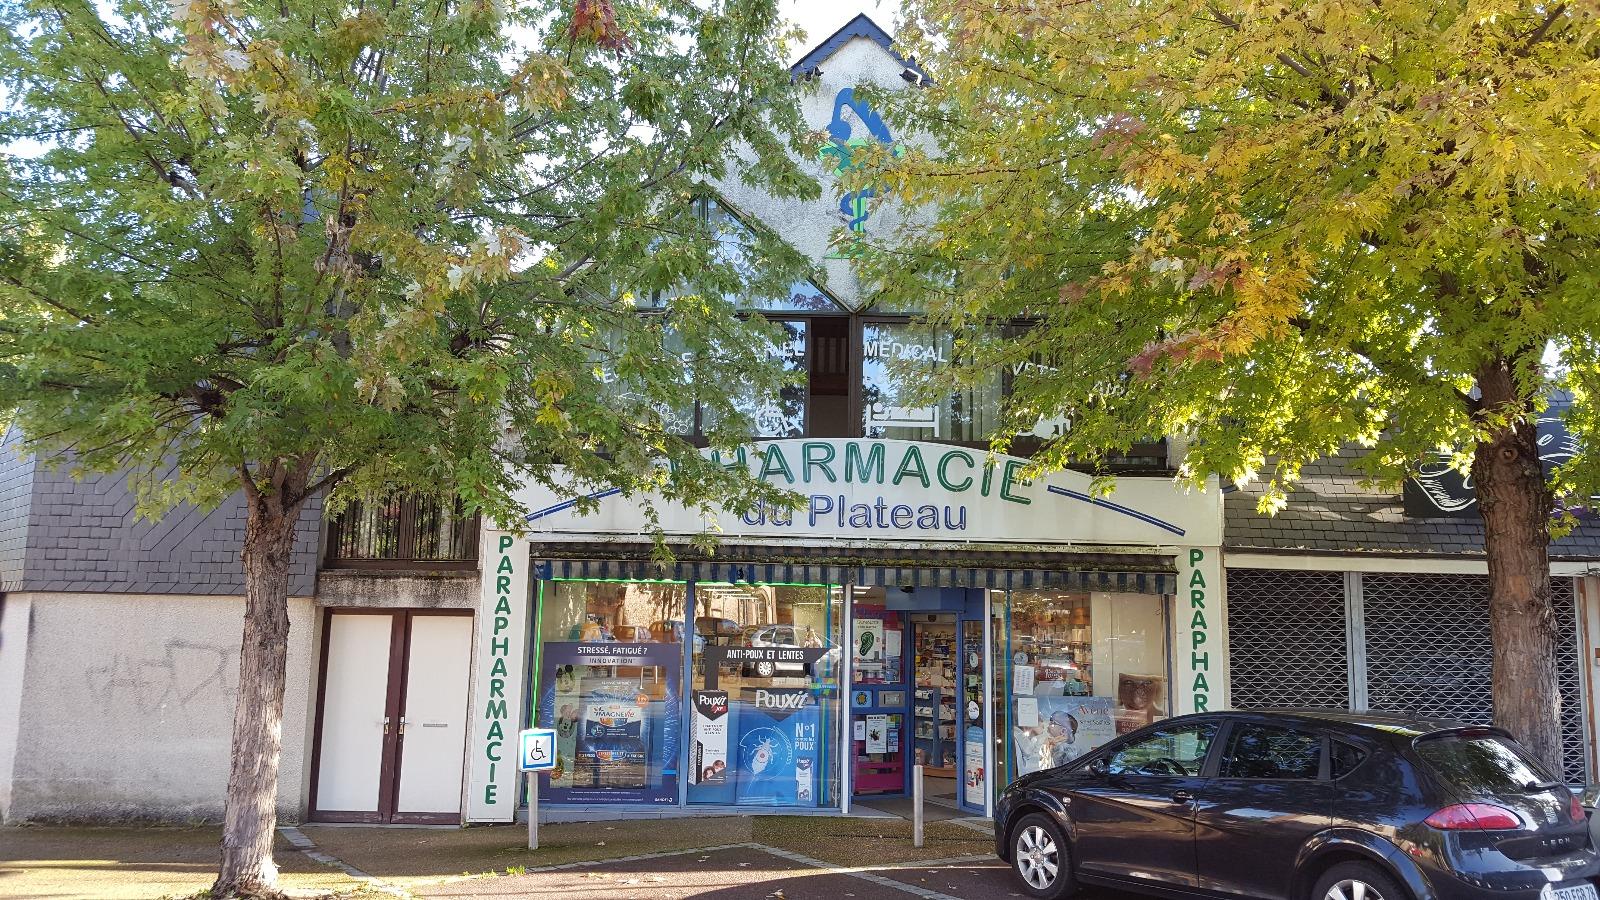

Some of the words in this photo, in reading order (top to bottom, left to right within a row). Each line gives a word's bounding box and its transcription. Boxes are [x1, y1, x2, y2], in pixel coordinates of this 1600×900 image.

[668, 440, 1033, 506] HARMACIE
[808, 495, 967, 530] Plateau
[577, 645, 611, 655] STRESSÉ,
[612, 646, 642, 655] FATIGUÉ
[643, 647, 648, 655] ?
[726, 649, 764, 660] ANTI-POUX
[766, 649, 776, 660] ET
[778, 650, 804, 660] LENTES
[485, 535, 514, 805] PARAPHARMACIE
[795, 722, 816, 738] N°1
[794, 741, 815, 751] POUX
